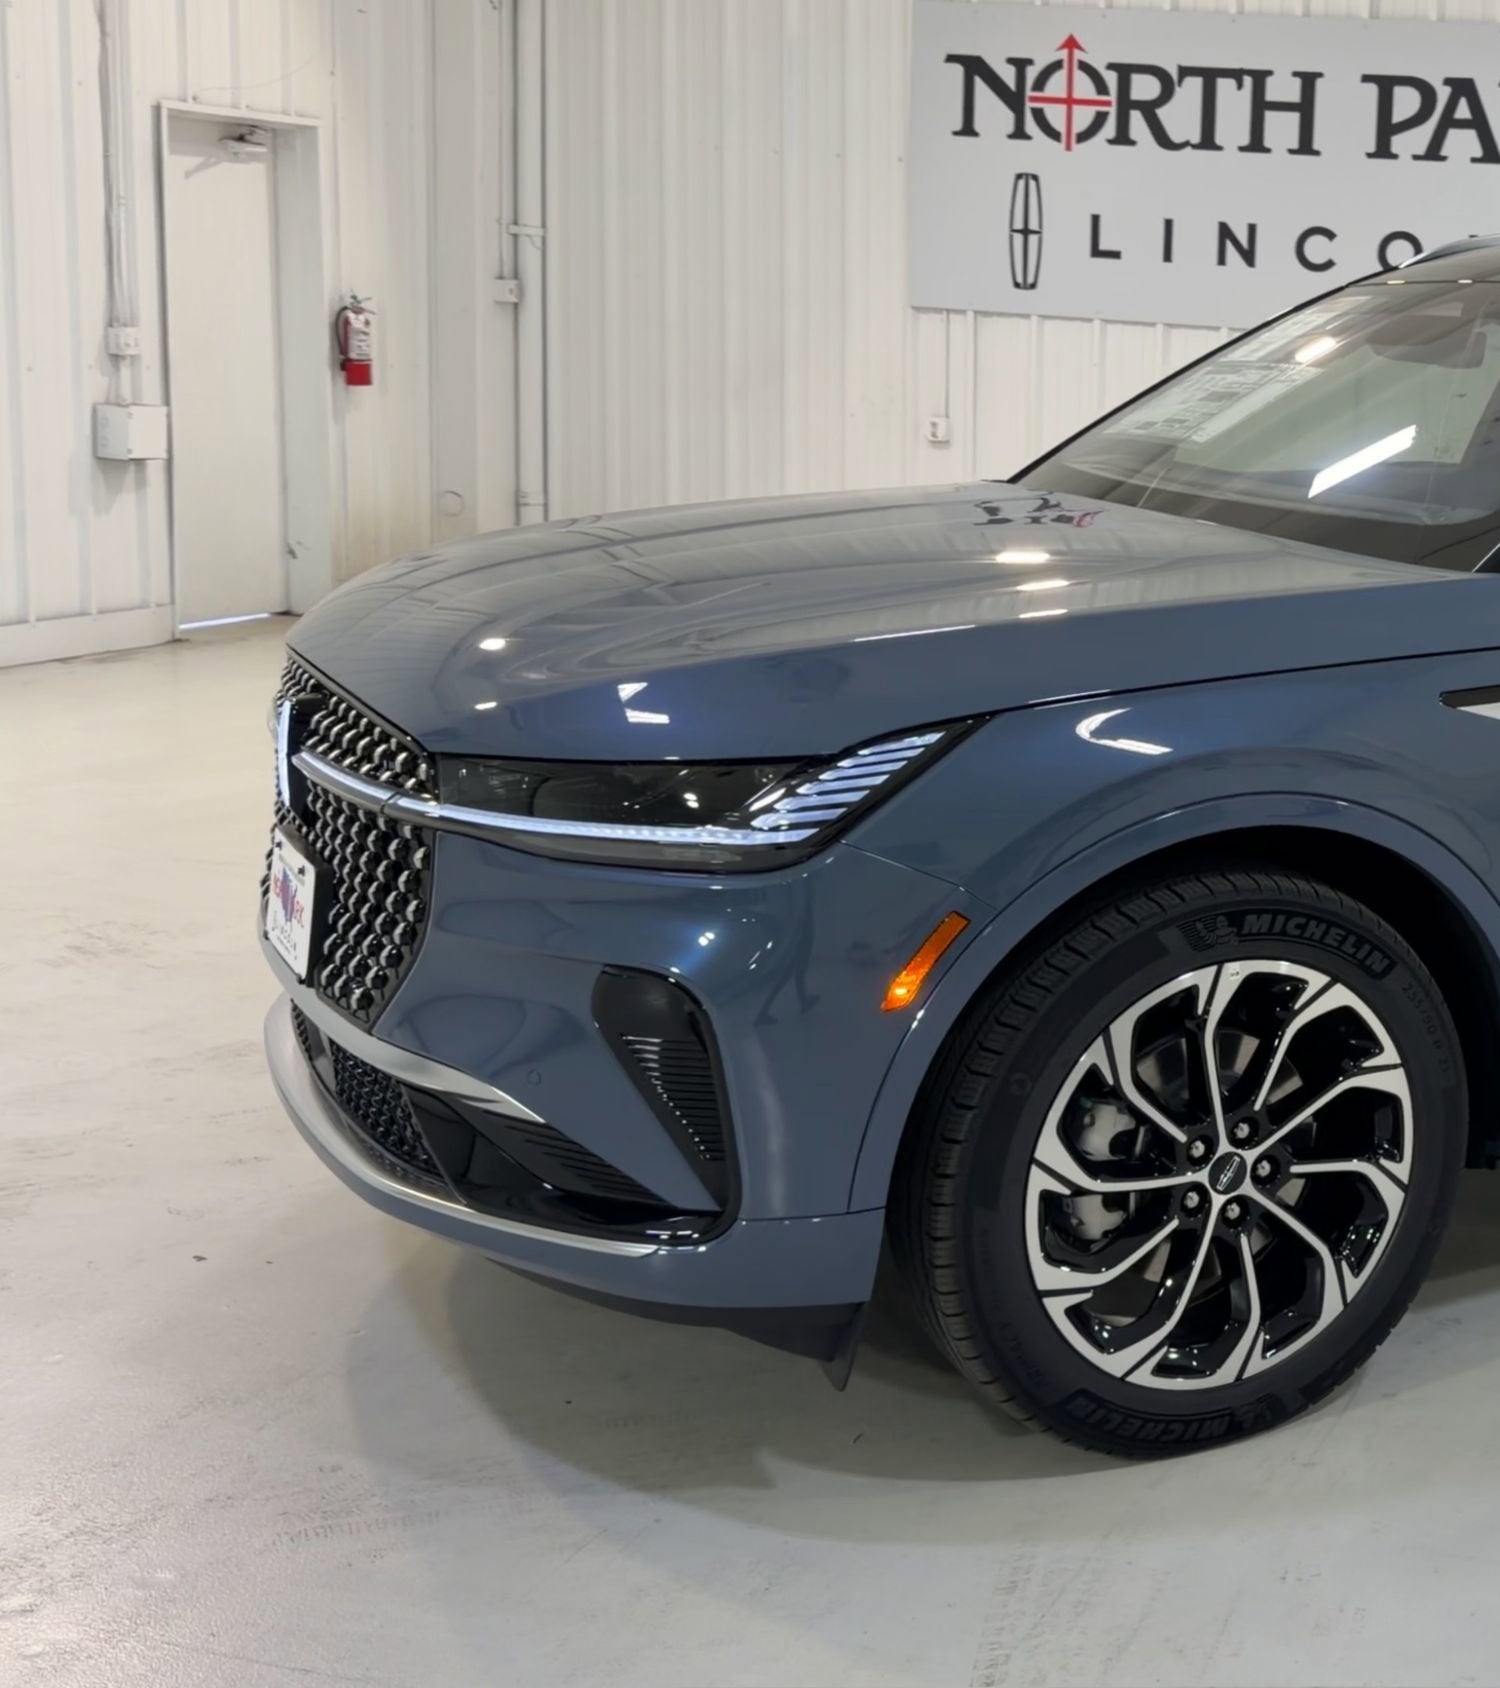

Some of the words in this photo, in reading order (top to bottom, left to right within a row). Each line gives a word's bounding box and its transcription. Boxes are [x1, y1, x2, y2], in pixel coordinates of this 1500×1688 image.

[944, 53, 1325, 156] NORTH
[1090, 213, 1480, 272] LINCO
[1241, 913, 1390, 974] MICHELIN
[1066, 1397, 1232, 1441] MICHELIN
